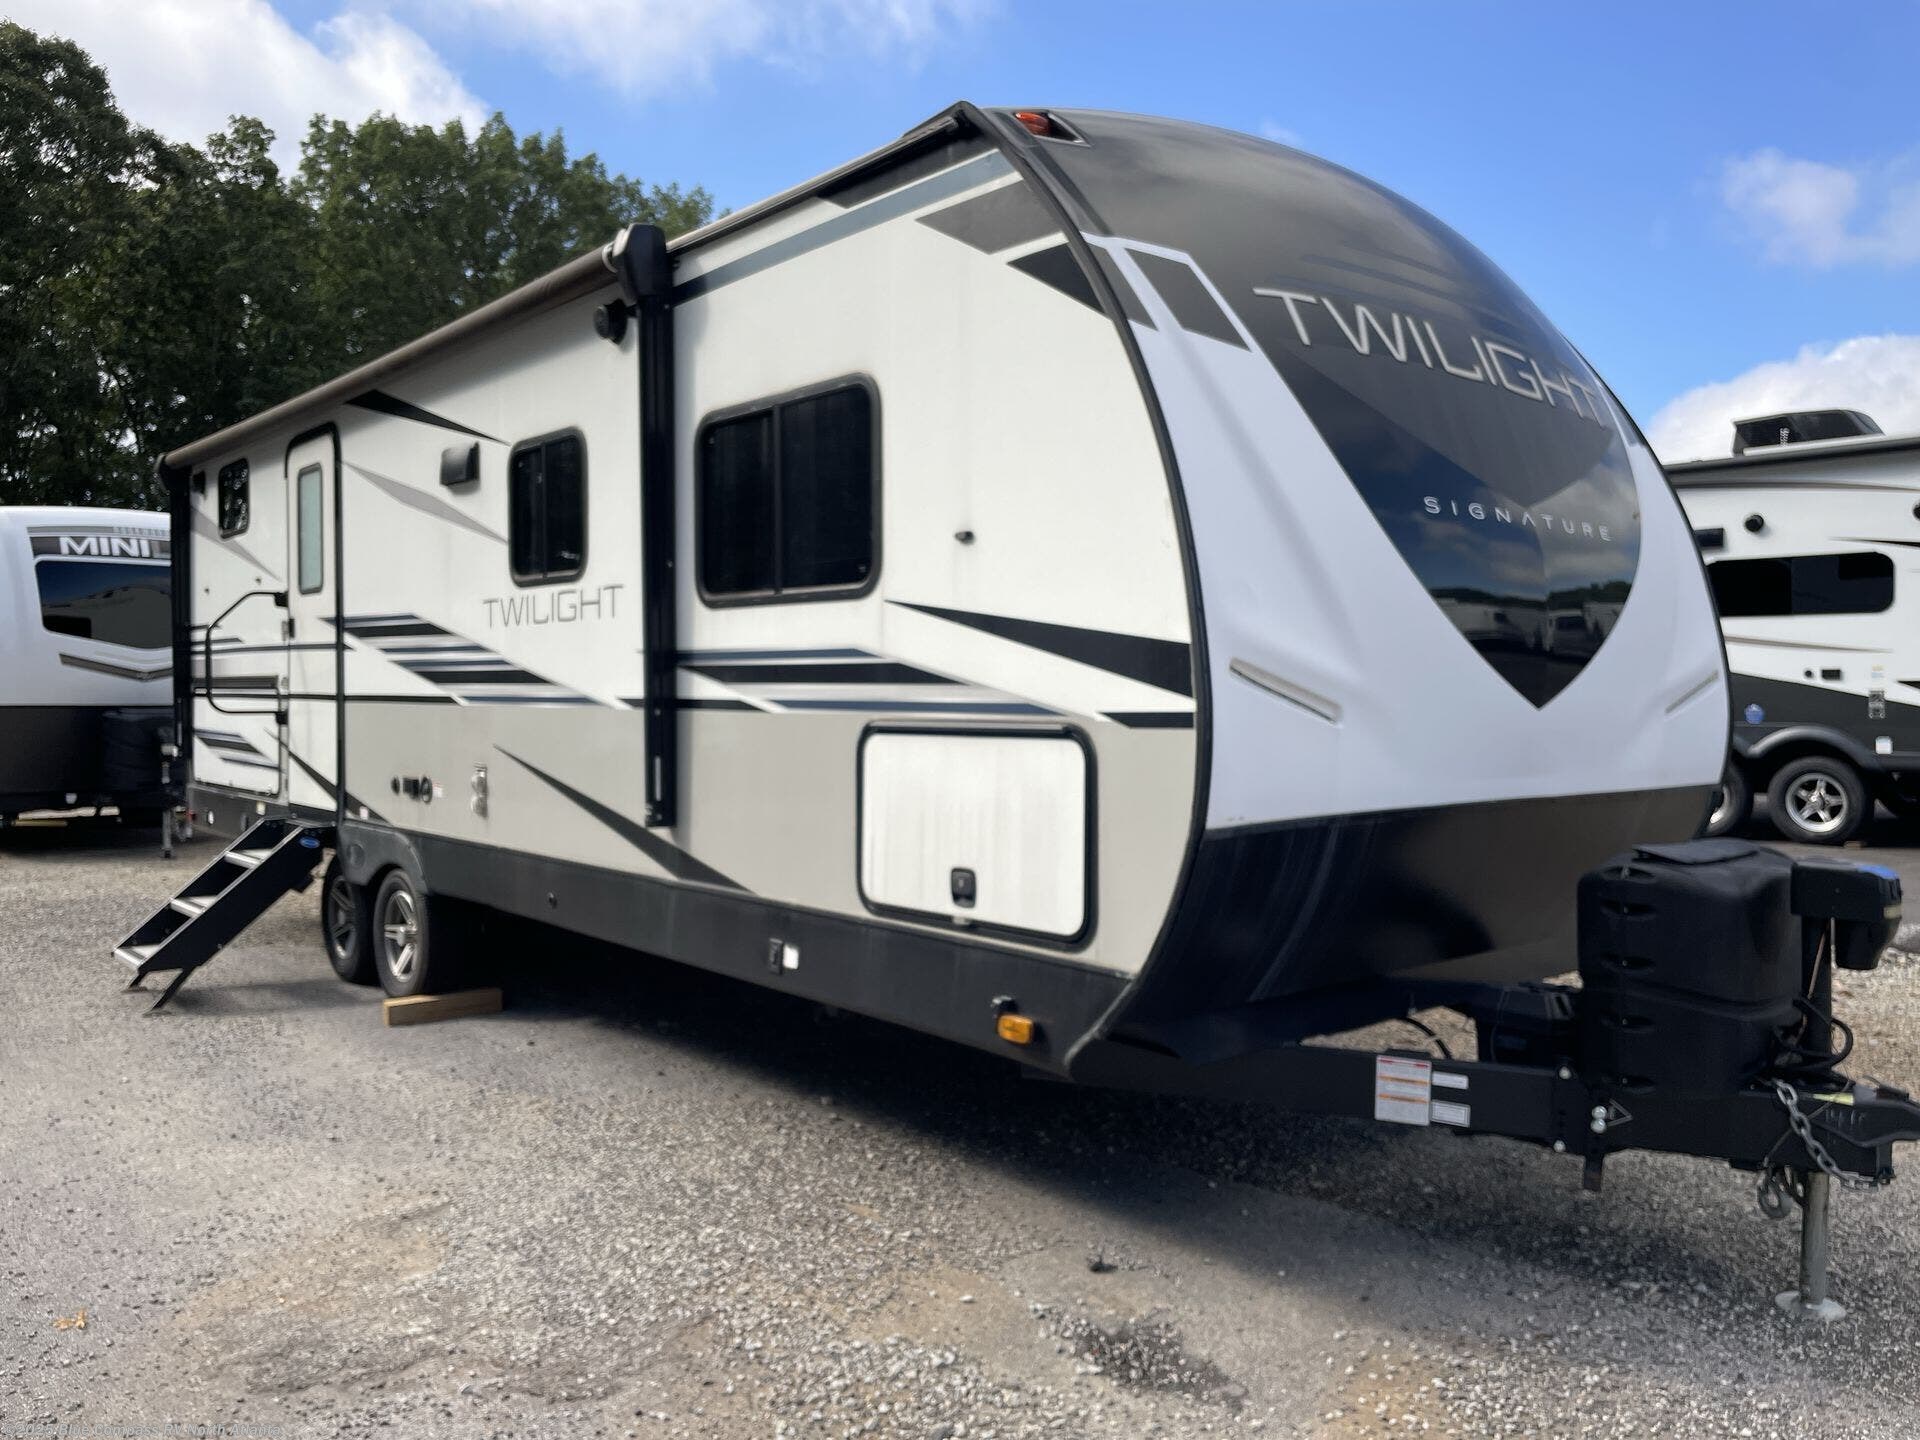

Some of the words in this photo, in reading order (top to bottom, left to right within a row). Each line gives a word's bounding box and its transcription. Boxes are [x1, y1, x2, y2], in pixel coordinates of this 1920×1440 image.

[1253, 286, 1602, 427] TWILIGHT
[1423, 496, 1612, 541] SIGNATURE
[483, 584, 624, 628] TWILIGHT
